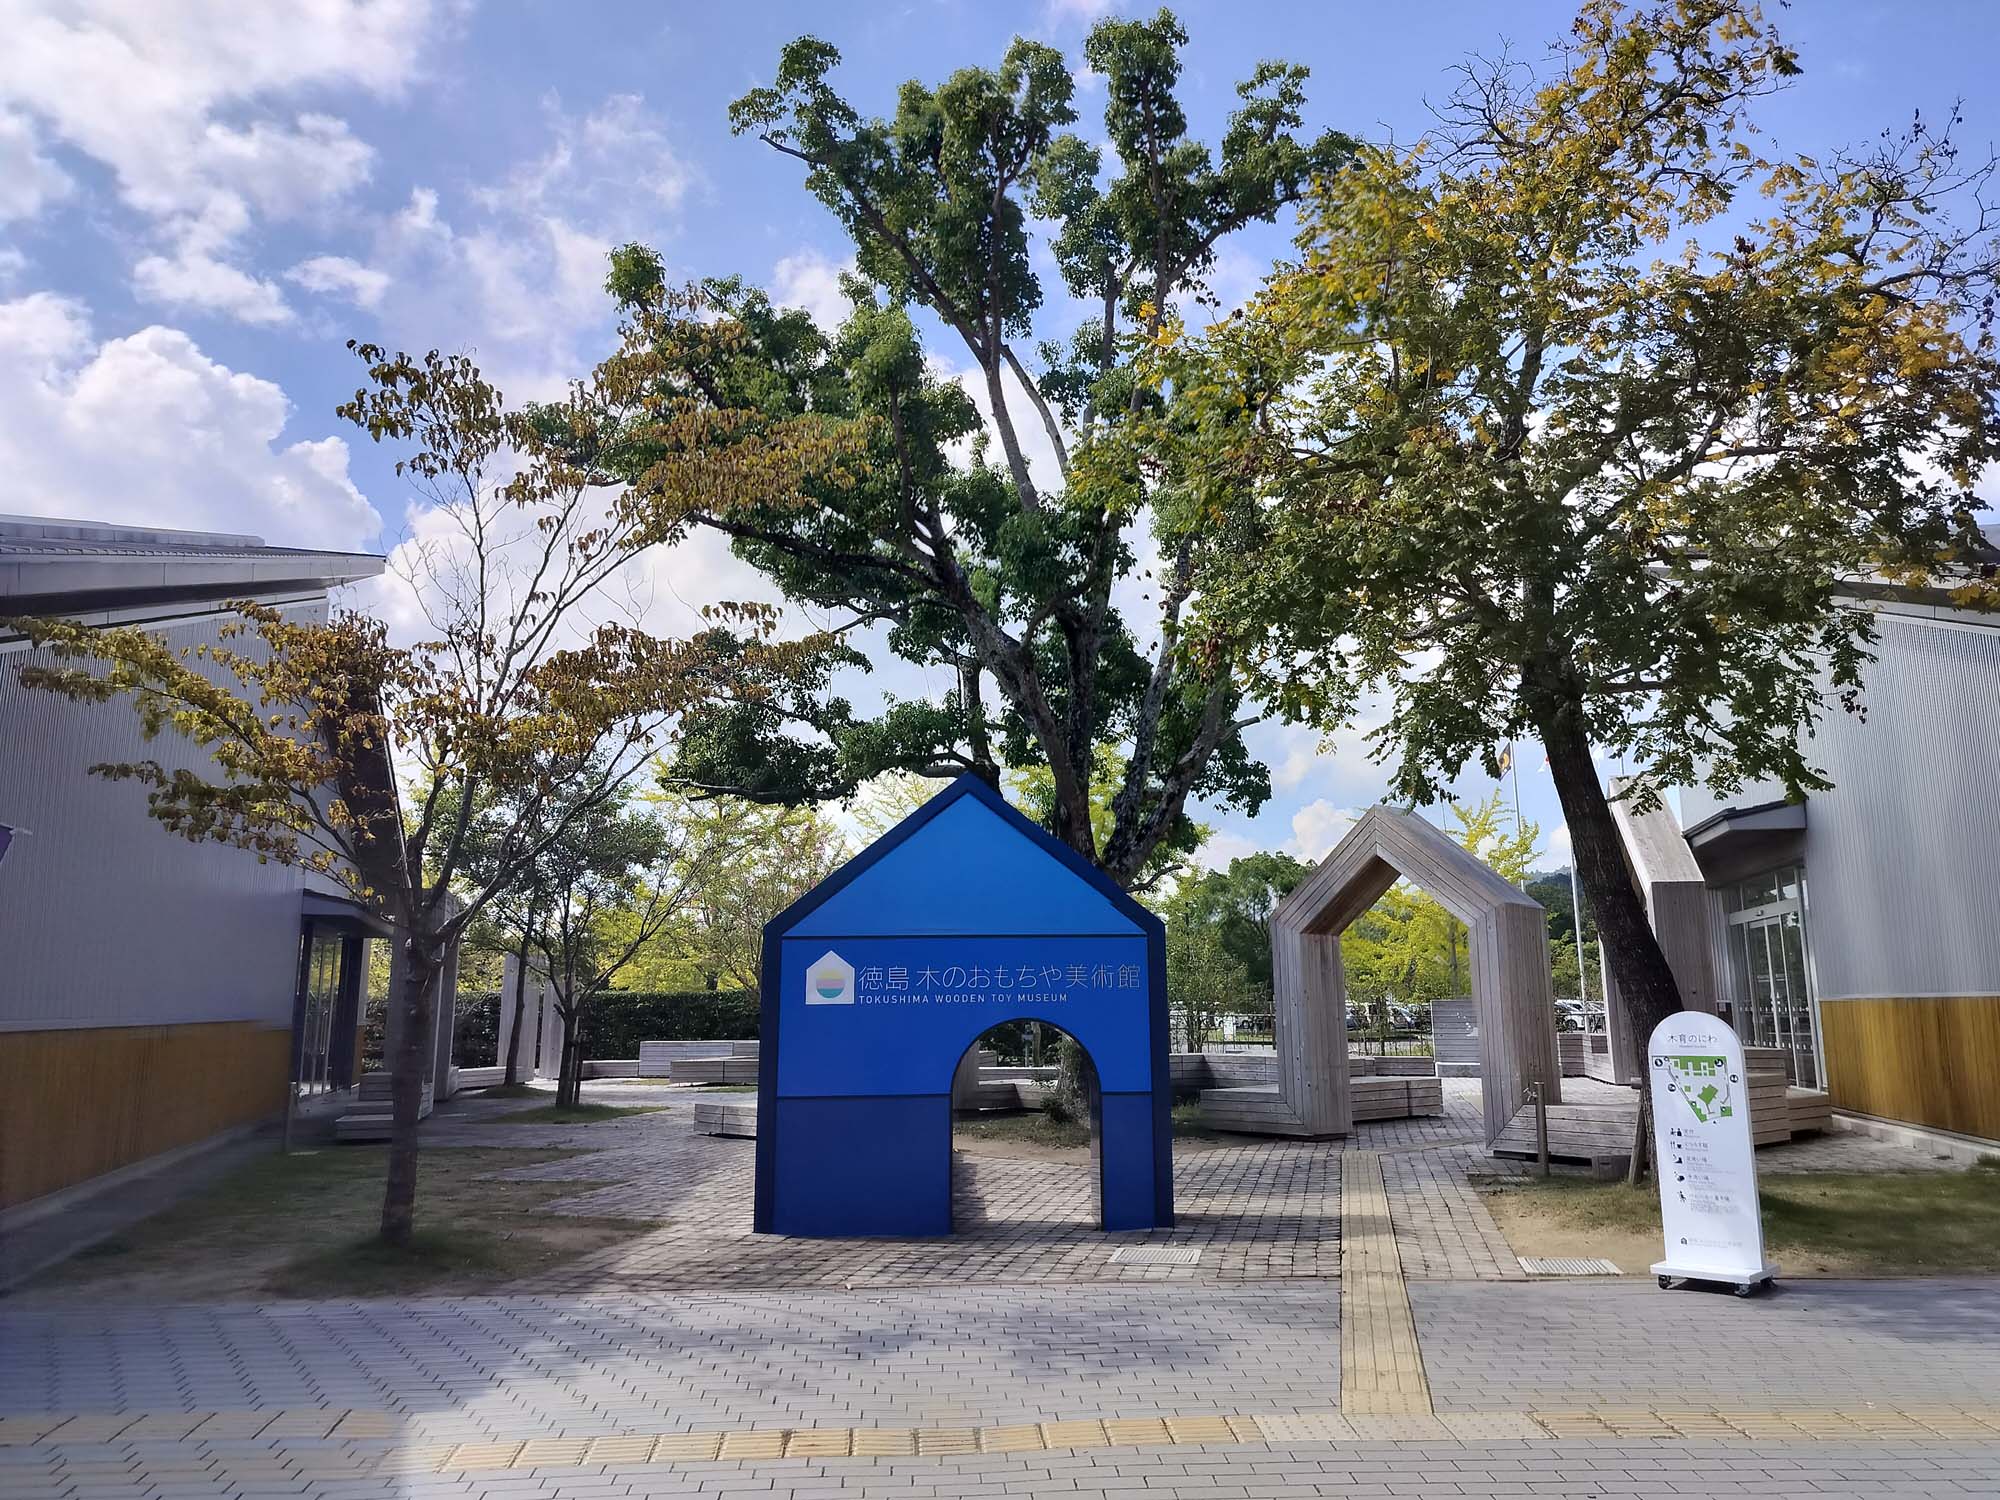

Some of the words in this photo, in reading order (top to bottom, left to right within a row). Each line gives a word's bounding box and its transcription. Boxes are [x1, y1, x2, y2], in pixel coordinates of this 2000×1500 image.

[858, 965, 910, 991] 徳島
[859, 995, 929, 1004] TOKUSHIMA
[935, 994, 985, 1003] WOODEN
[991, 994, 1012, 1003] TOY
[1017, 993, 1067, 1002] MUSEUM
